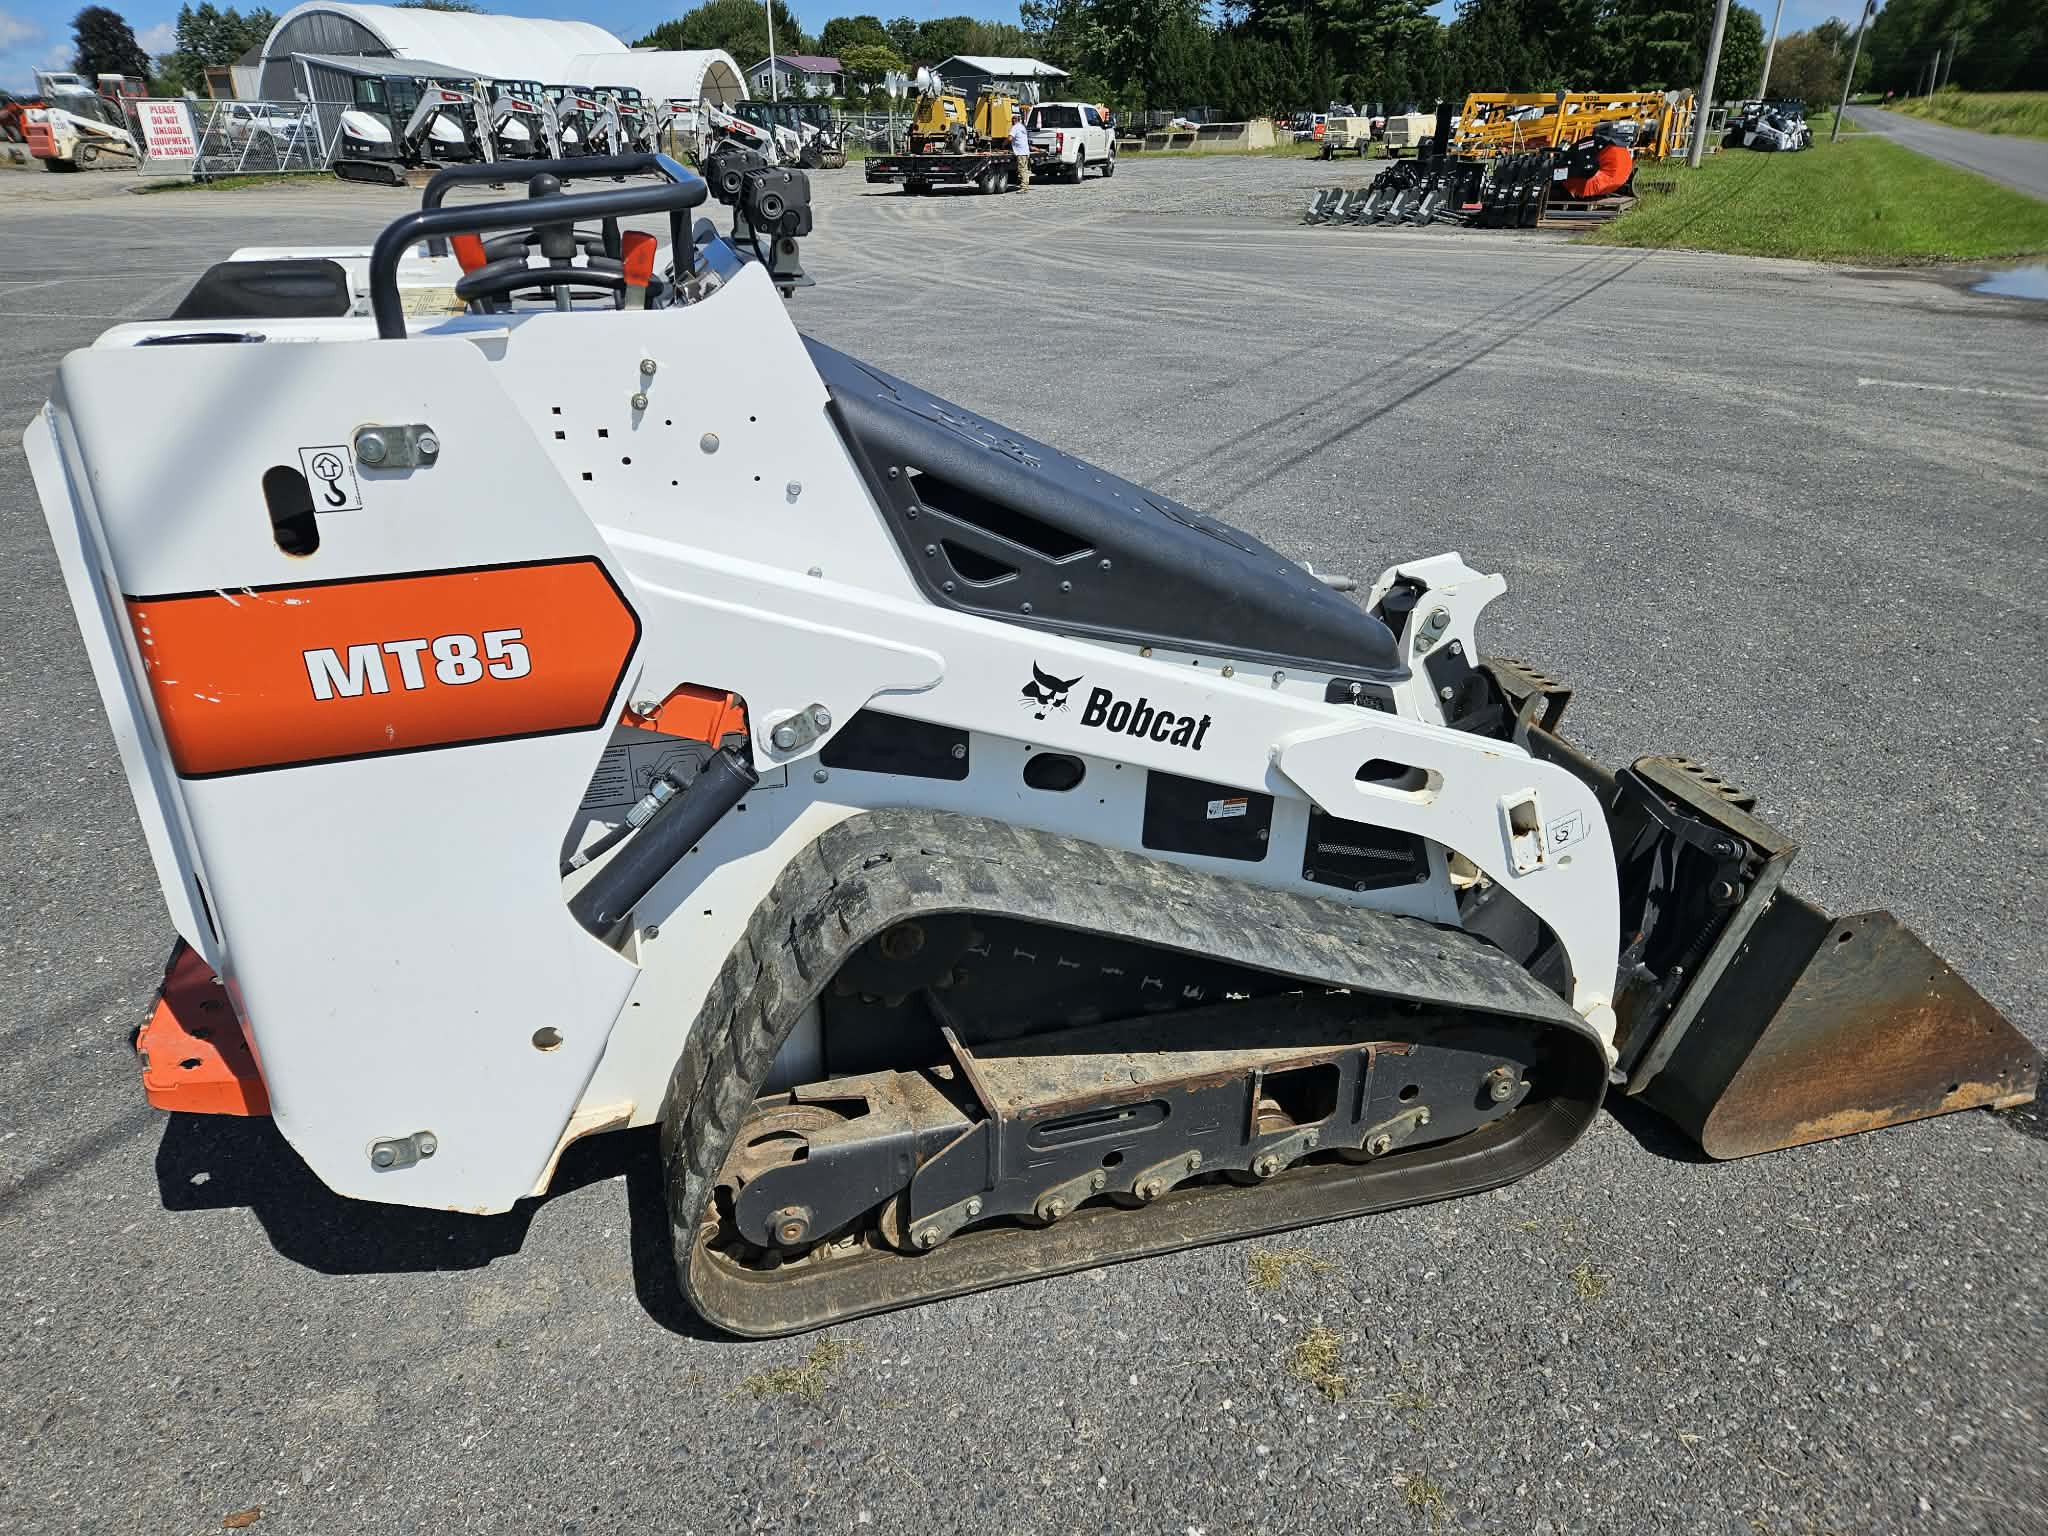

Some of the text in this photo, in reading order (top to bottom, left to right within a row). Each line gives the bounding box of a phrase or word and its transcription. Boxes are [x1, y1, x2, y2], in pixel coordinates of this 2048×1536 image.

[149, 105, 176, 114] PLEASE
[151, 116, 179, 125] DO NOT
[153, 127, 183, 135] UNLOAD
[149, 137, 191, 146] EQUIPMENT
[151, 147, 194, 156] ON ASPHALT
[302, 628, 532, 701] MT85
[1080, 686, 1212, 751] Bobcat
